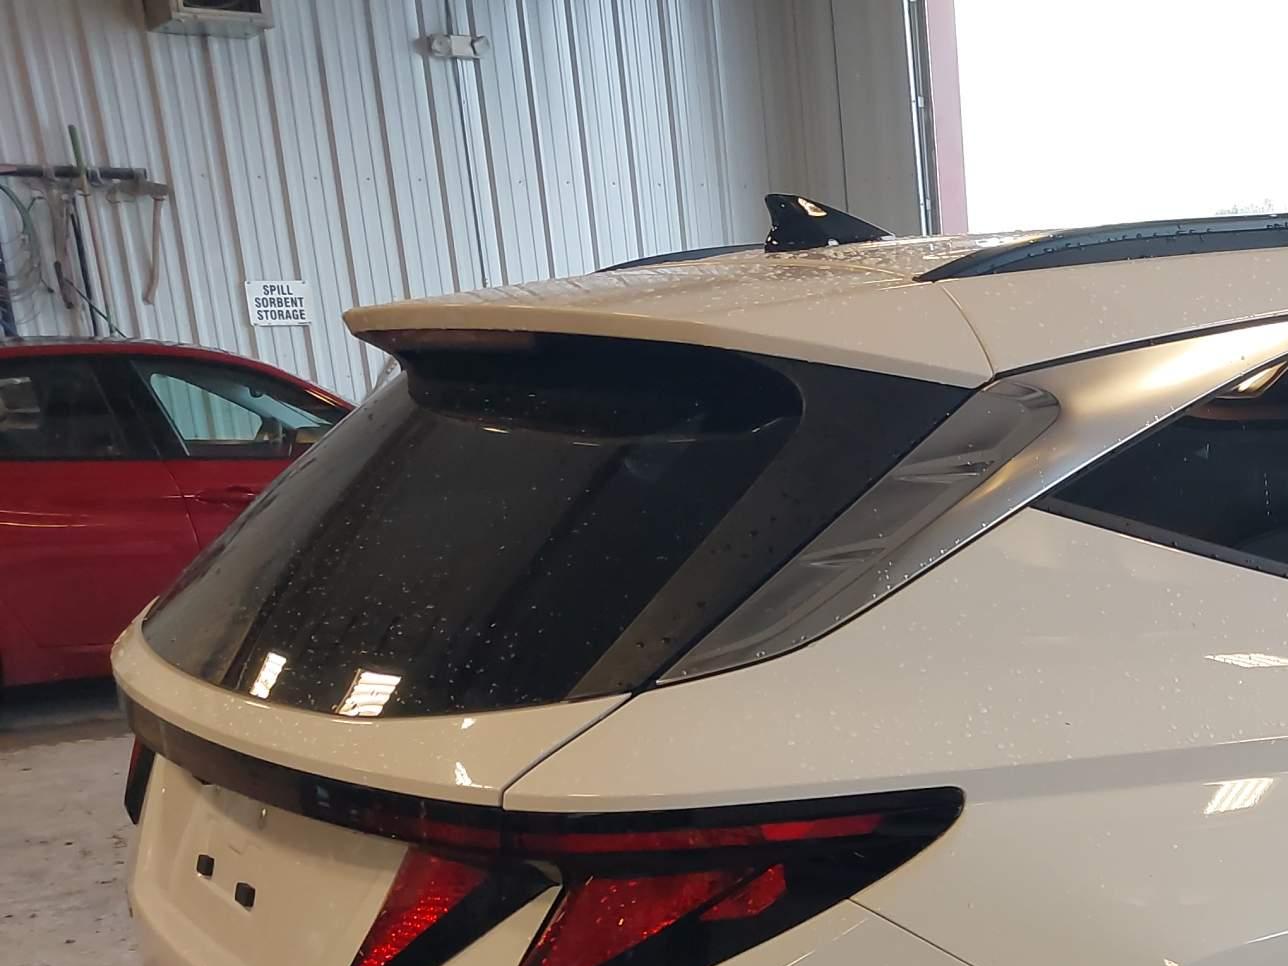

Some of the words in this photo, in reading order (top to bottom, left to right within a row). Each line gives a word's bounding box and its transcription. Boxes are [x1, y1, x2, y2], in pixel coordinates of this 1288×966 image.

[262, 284, 293, 296] SPILL
[254, 296, 304, 308] SORBENT
[256, 309, 306, 321] STORAGE
